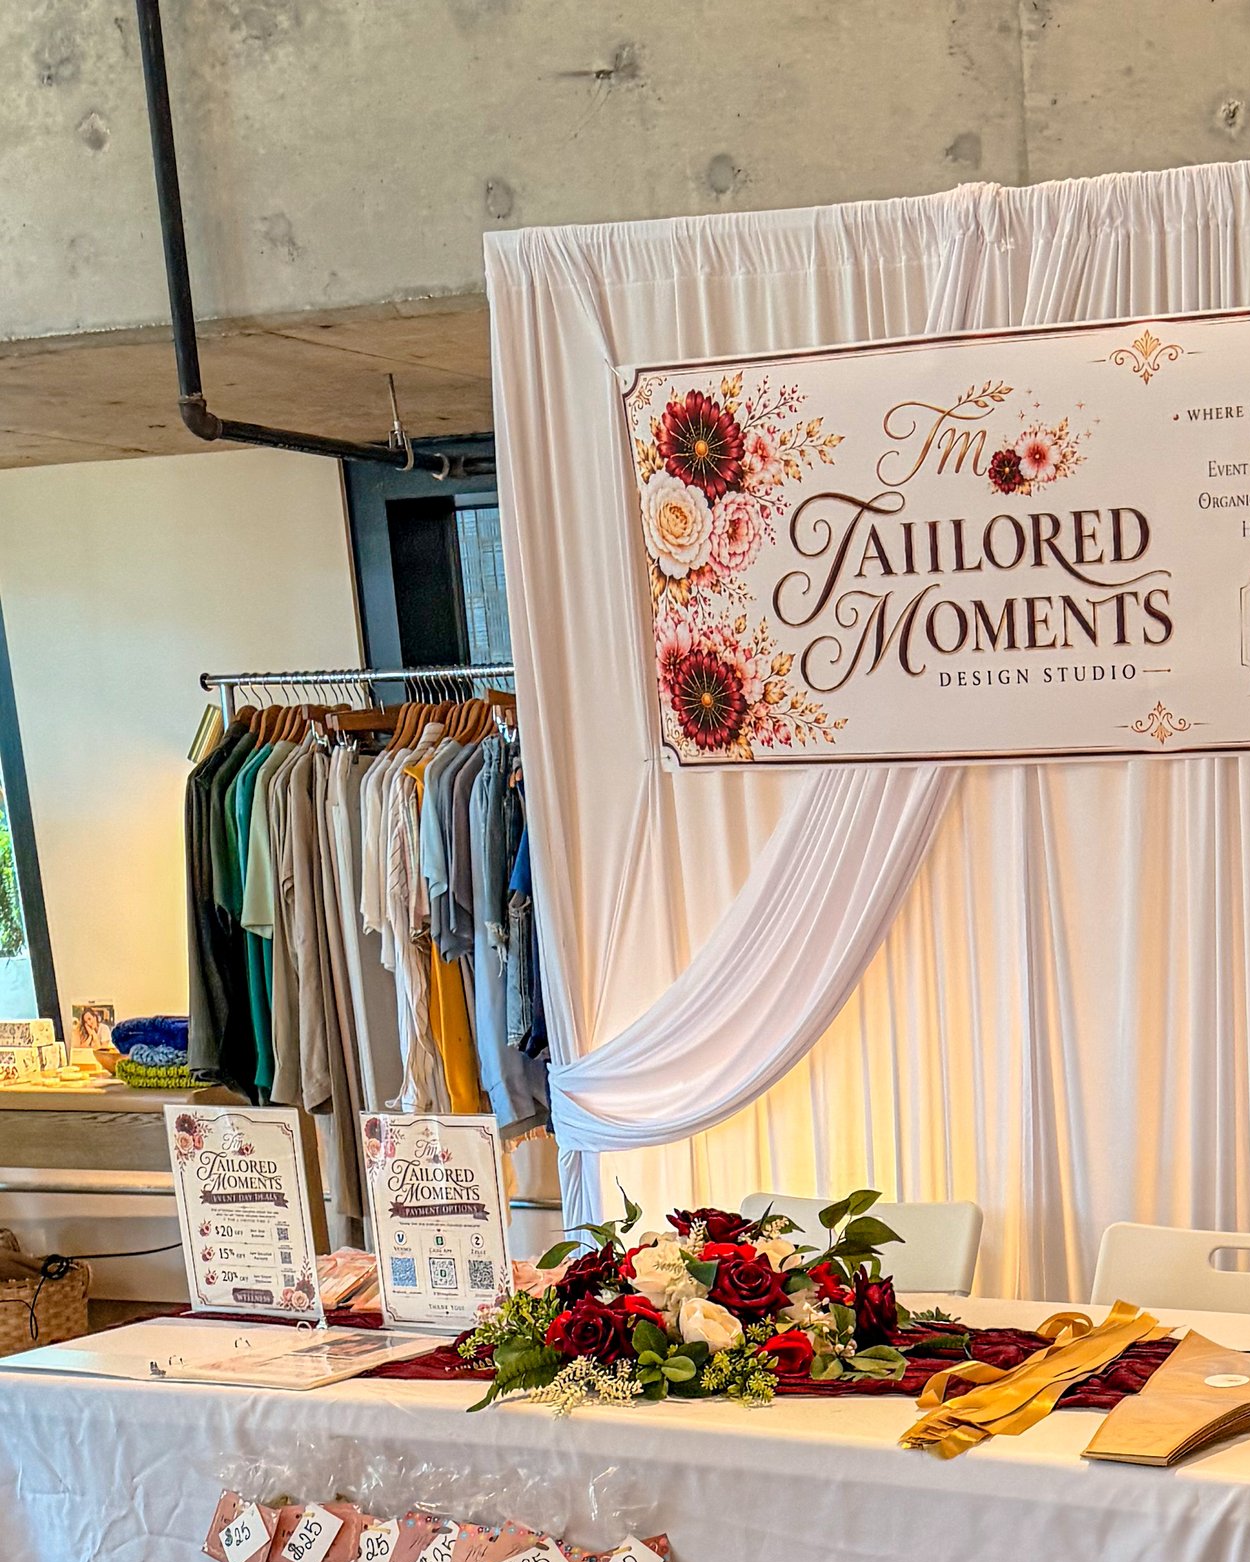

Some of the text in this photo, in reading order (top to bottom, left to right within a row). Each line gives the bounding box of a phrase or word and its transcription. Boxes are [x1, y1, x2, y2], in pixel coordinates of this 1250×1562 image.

[1187, 404, 1245, 422] WHERE
[1208, 460, 1248, 478] EVENT
[801, 583, 1174, 694] MOMENTS
[938, 663, 1138, 688] DESIGN STUDIO
[197, 1150, 282, 1181] TAILORED
[203, 1173, 283, 1192] MOMENTS
[388, 1159, 479, 1192] TAILORED
[239, 1193, 253, 1202] DAY
[395, 1183, 480, 1204] MOMENTS
[405, 1203, 478, 1216] PAYMENT OPTIONS
[215, 1225, 233, 1237] $20
[219, 1248, 235, 1260] 15%
[221, 1270, 239, 1282] 20%
[224, 1520, 251, 1547] $25
[287, 1519, 323, 1561] $25
